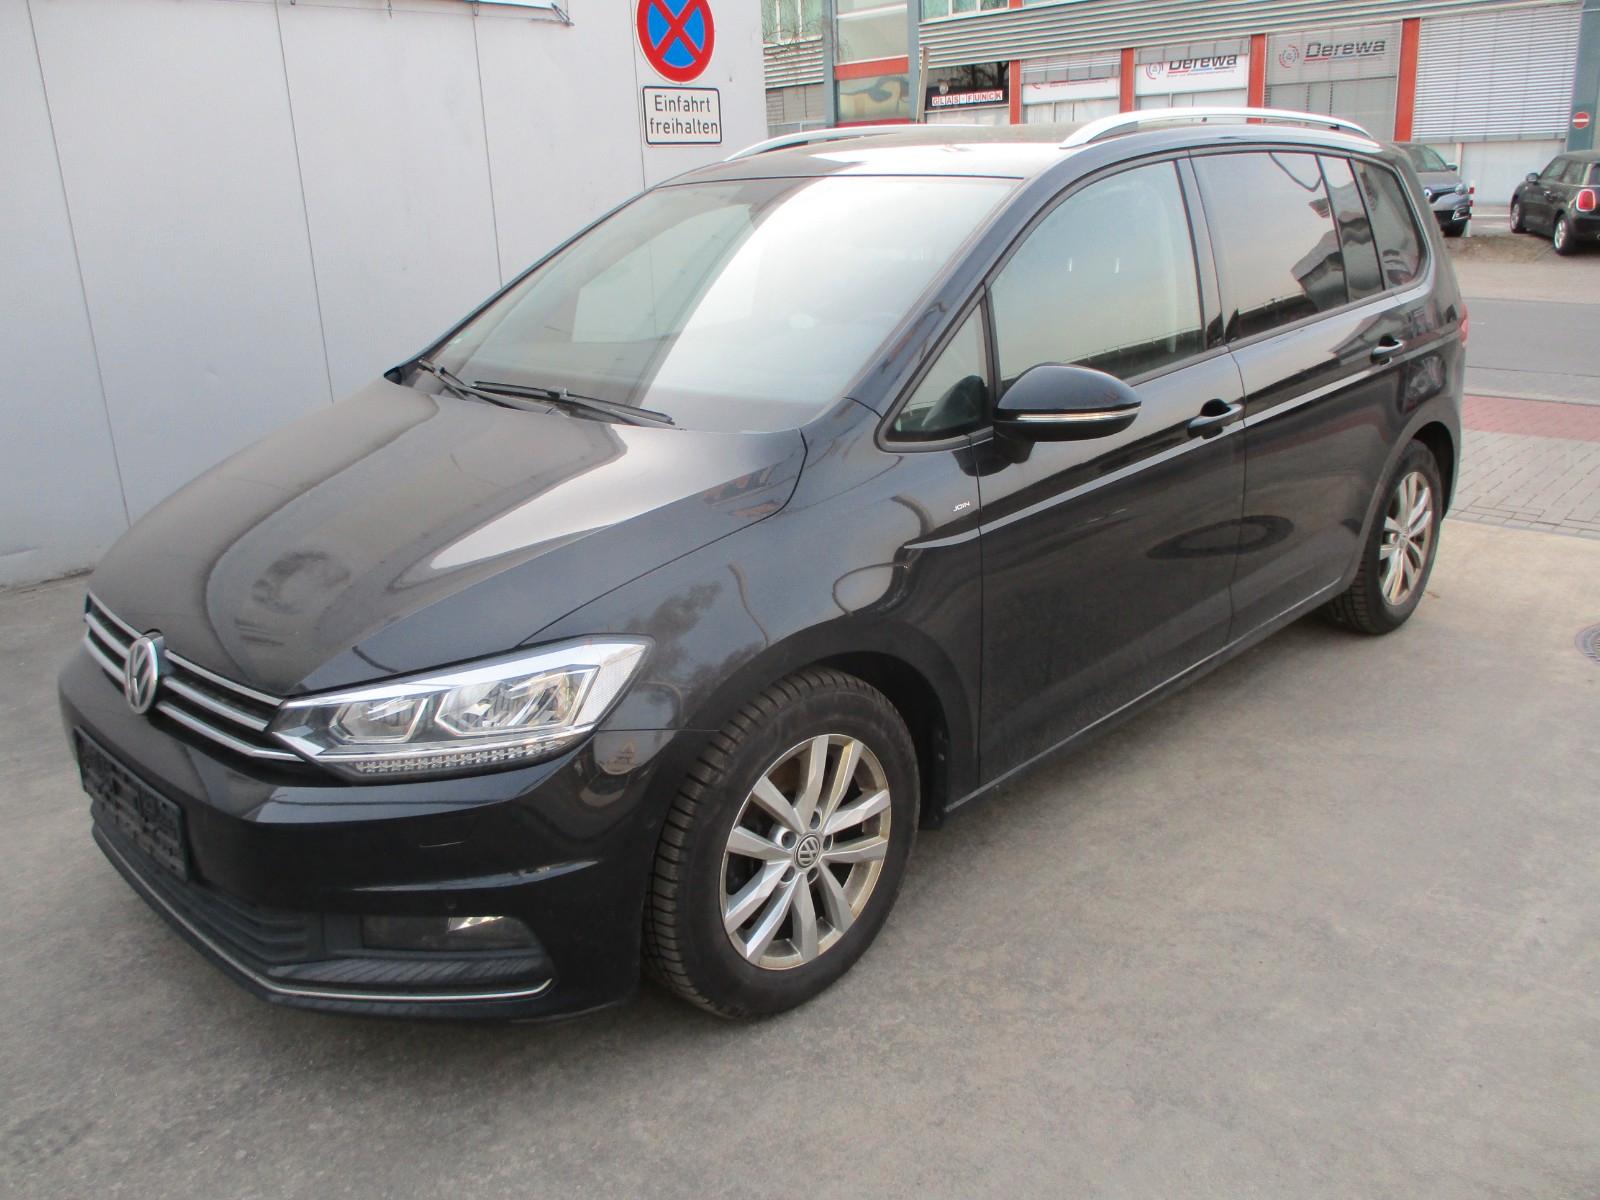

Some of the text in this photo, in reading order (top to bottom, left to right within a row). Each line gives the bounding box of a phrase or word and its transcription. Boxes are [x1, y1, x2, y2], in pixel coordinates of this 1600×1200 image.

[1305, 40, 1386, 58] Derewa
[654, 95, 711, 112] Einfahrt
[932, 95, 960, 106] GLAS
[650, 117, 718, 135] freihalten
